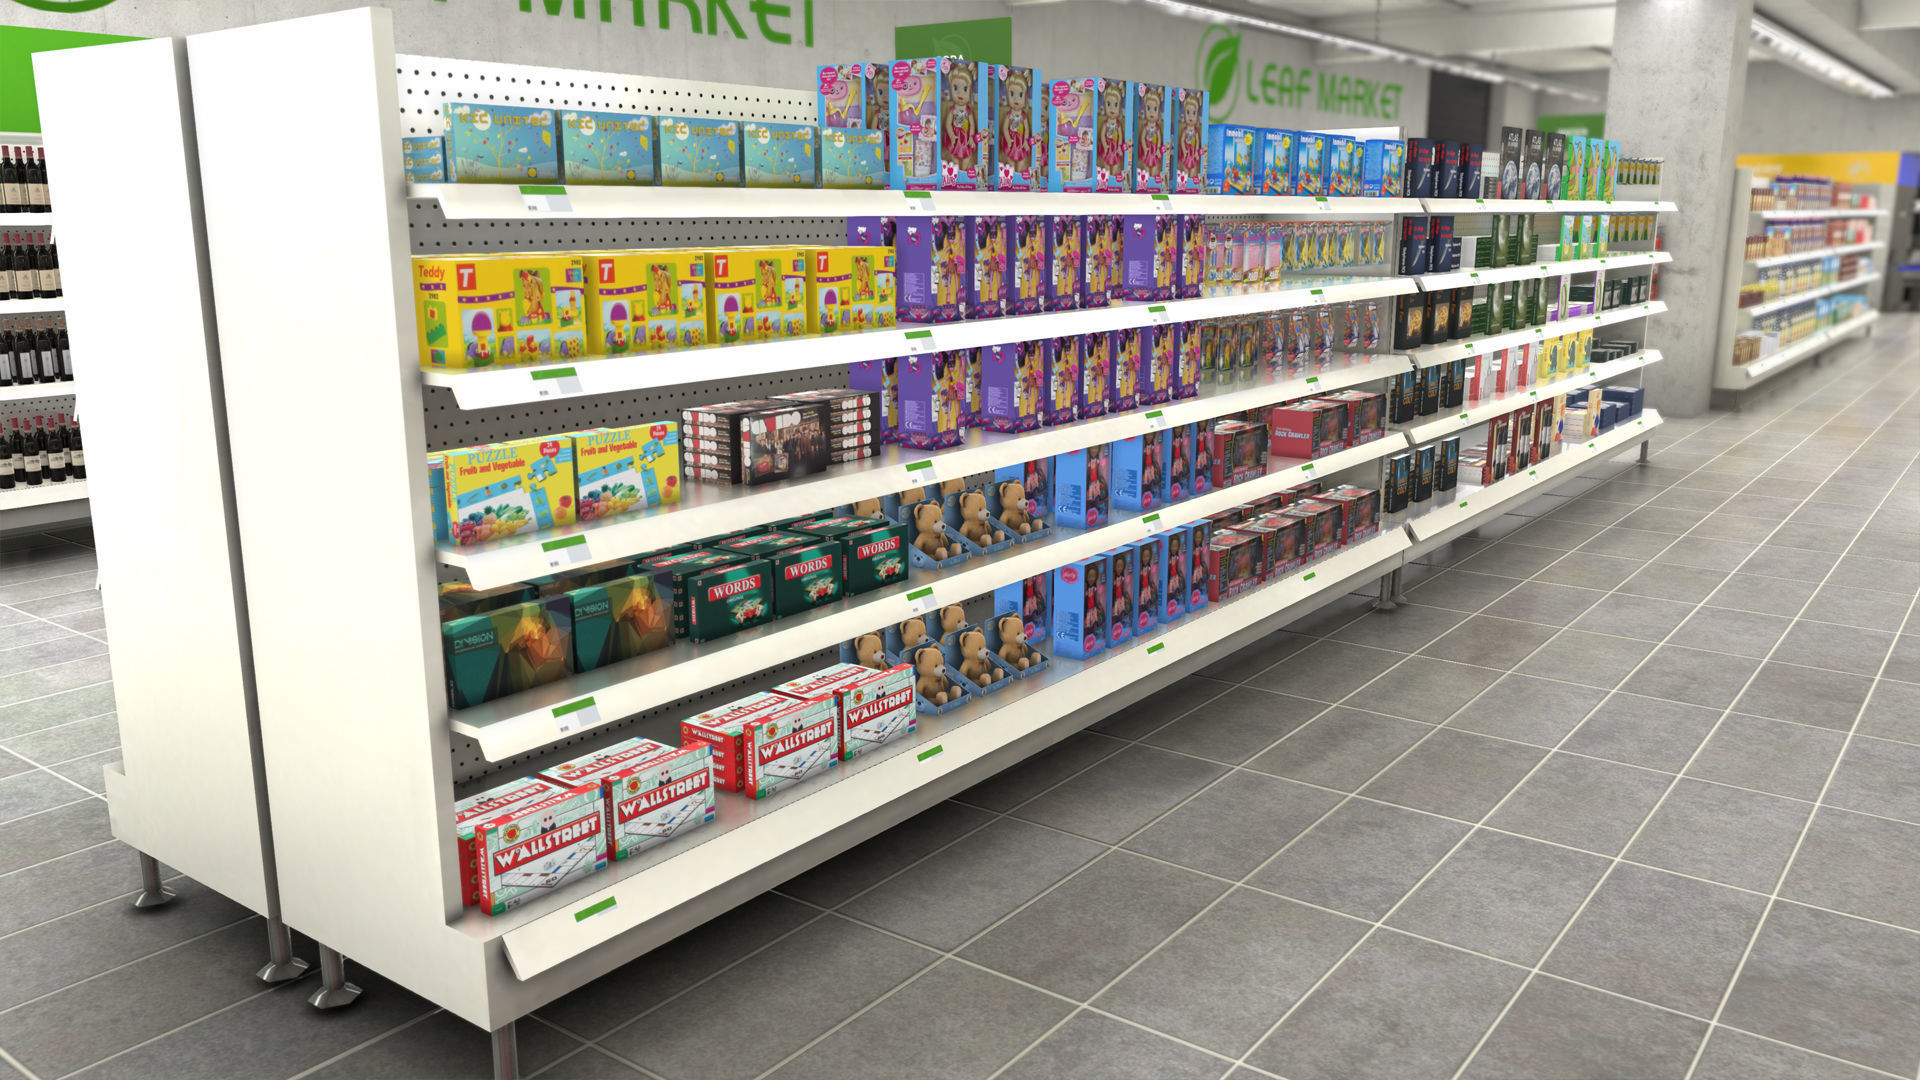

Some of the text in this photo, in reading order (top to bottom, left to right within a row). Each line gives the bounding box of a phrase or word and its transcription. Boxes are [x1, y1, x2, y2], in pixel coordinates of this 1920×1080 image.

[1246, 60, 1403, 120] LEAF MARKET
[601, 263, 613, 281] T
[717, 258, 727, 275] T
[819, 255, 828, 270] T
[418, 265, 445, 280] Teddy
[459, 268, 473, 288] T
[587, 430, 632, 446] PUZZLE
[467, 447, 518, 465] PUZZLE
[479, 462, 491, 473] and
[861, 539, 896, 557] WORDS
[789, 558, 828, 577] WORDS
[713, 578, 756, 598] WORDS
[574, 601, 609, 617] DIVISION
[454, 631, 494, 649] DIVISION
[792, 667, 862, 693] WALLSTREET
[703, 696, 781, 726] WALLSTREET
[848, 689, 912, 723] WALLSTREET
[759, 719, 834, 760] WALLSTREET
[560, 743, 656, 780] WALLSTREET
[619, 772, 707, 818] WALLSTREET
[495, 816, 598, 868] WALLSTREET
